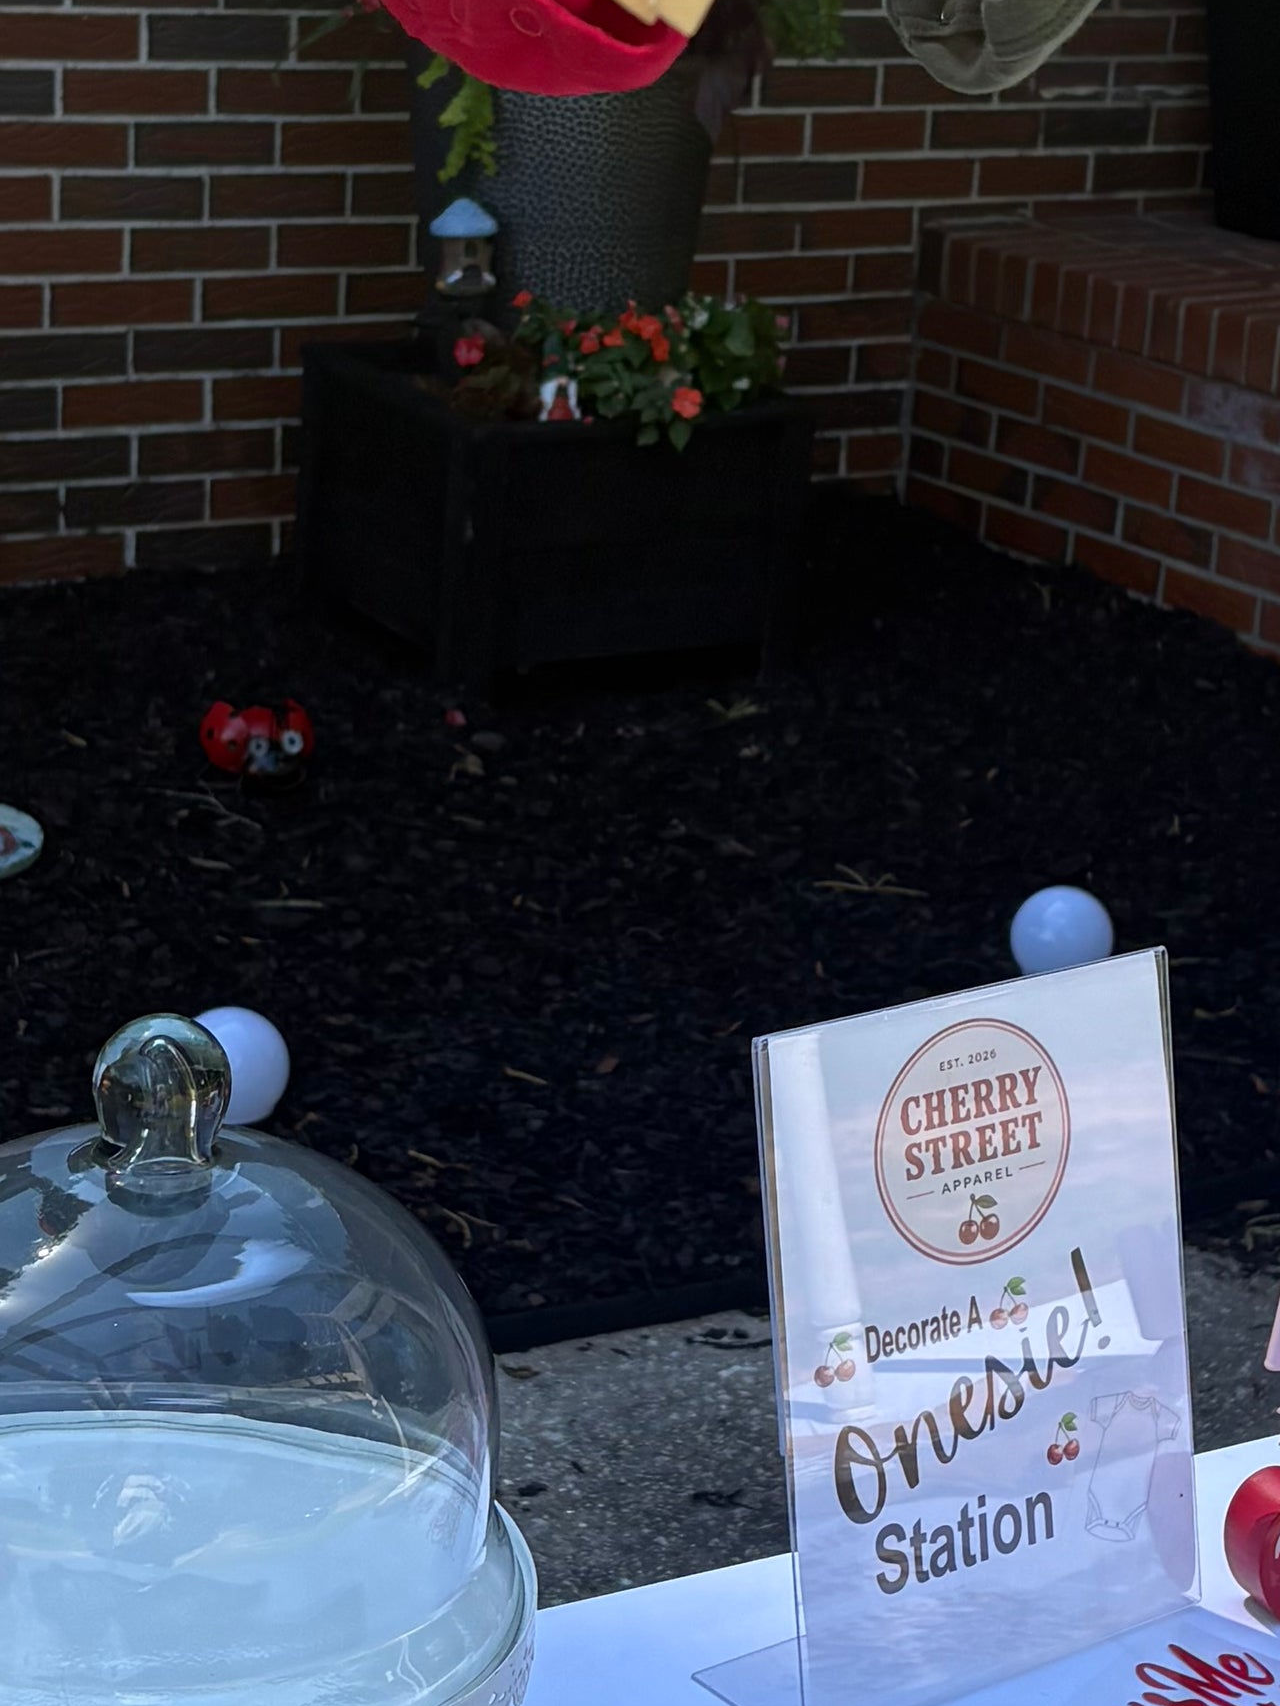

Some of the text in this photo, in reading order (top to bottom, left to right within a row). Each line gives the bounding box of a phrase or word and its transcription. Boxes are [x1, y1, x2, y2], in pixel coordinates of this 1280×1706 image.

[968, 1048, 998, 1065] 2026
[900, 1065, 1042, 1136] CHERRY
[904, 1111, 1043, 1182] STREET
[941, 1166, 1014, 1195] APPAREL
[865, 1295, 983, 1364] Decorate A
[874, 1491, 1055, 1595] Station
